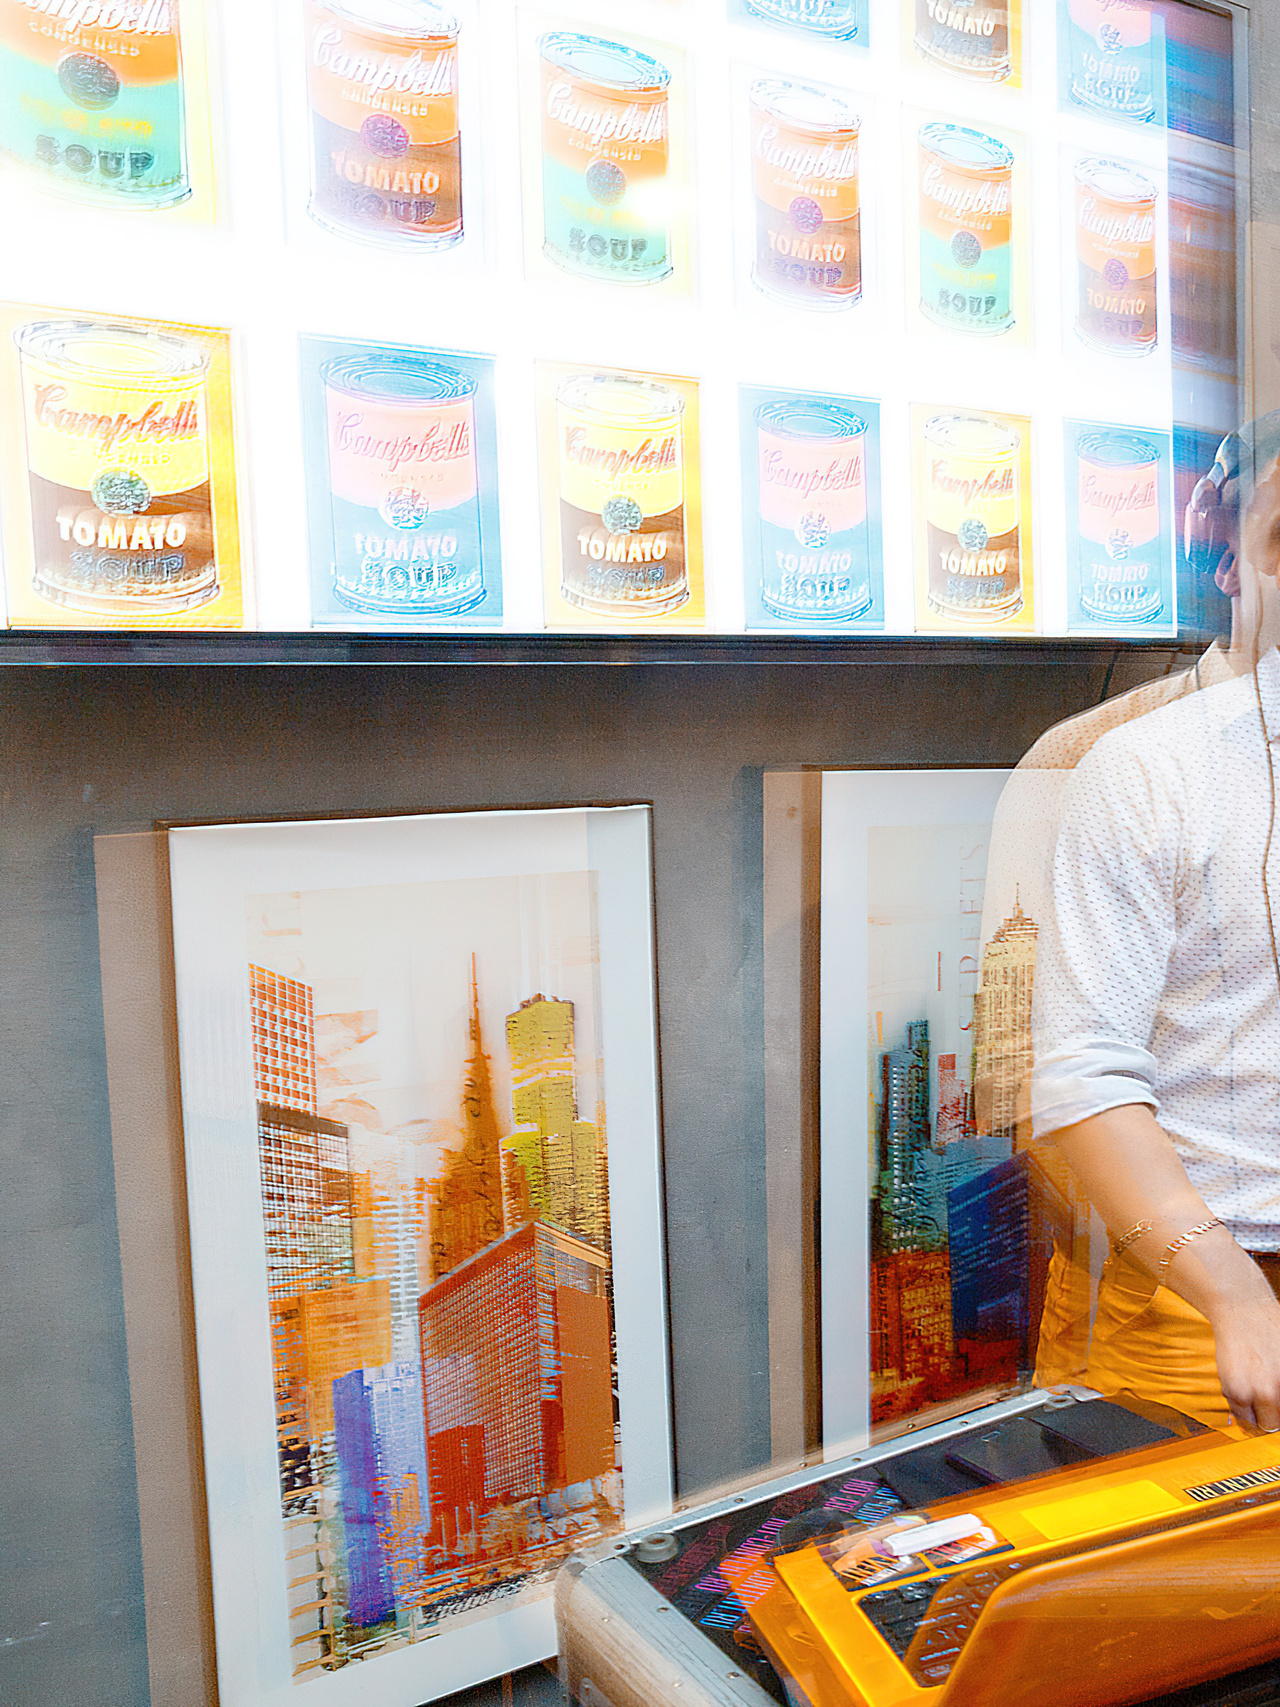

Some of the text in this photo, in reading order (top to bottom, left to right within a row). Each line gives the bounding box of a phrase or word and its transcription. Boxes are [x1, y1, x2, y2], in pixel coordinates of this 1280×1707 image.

[331, 149, 440, 194] TOMATO
[768, 230, 846, 264] TOMATO
[55, 514, 187, 550] TOMATO
[354, 532, 457, 560] TOMATO
[576, 533, 668, 563] TOMATO
[775, 550, 851, 574] TOMATO
[938, 550, 1007, 577] TOMATO
